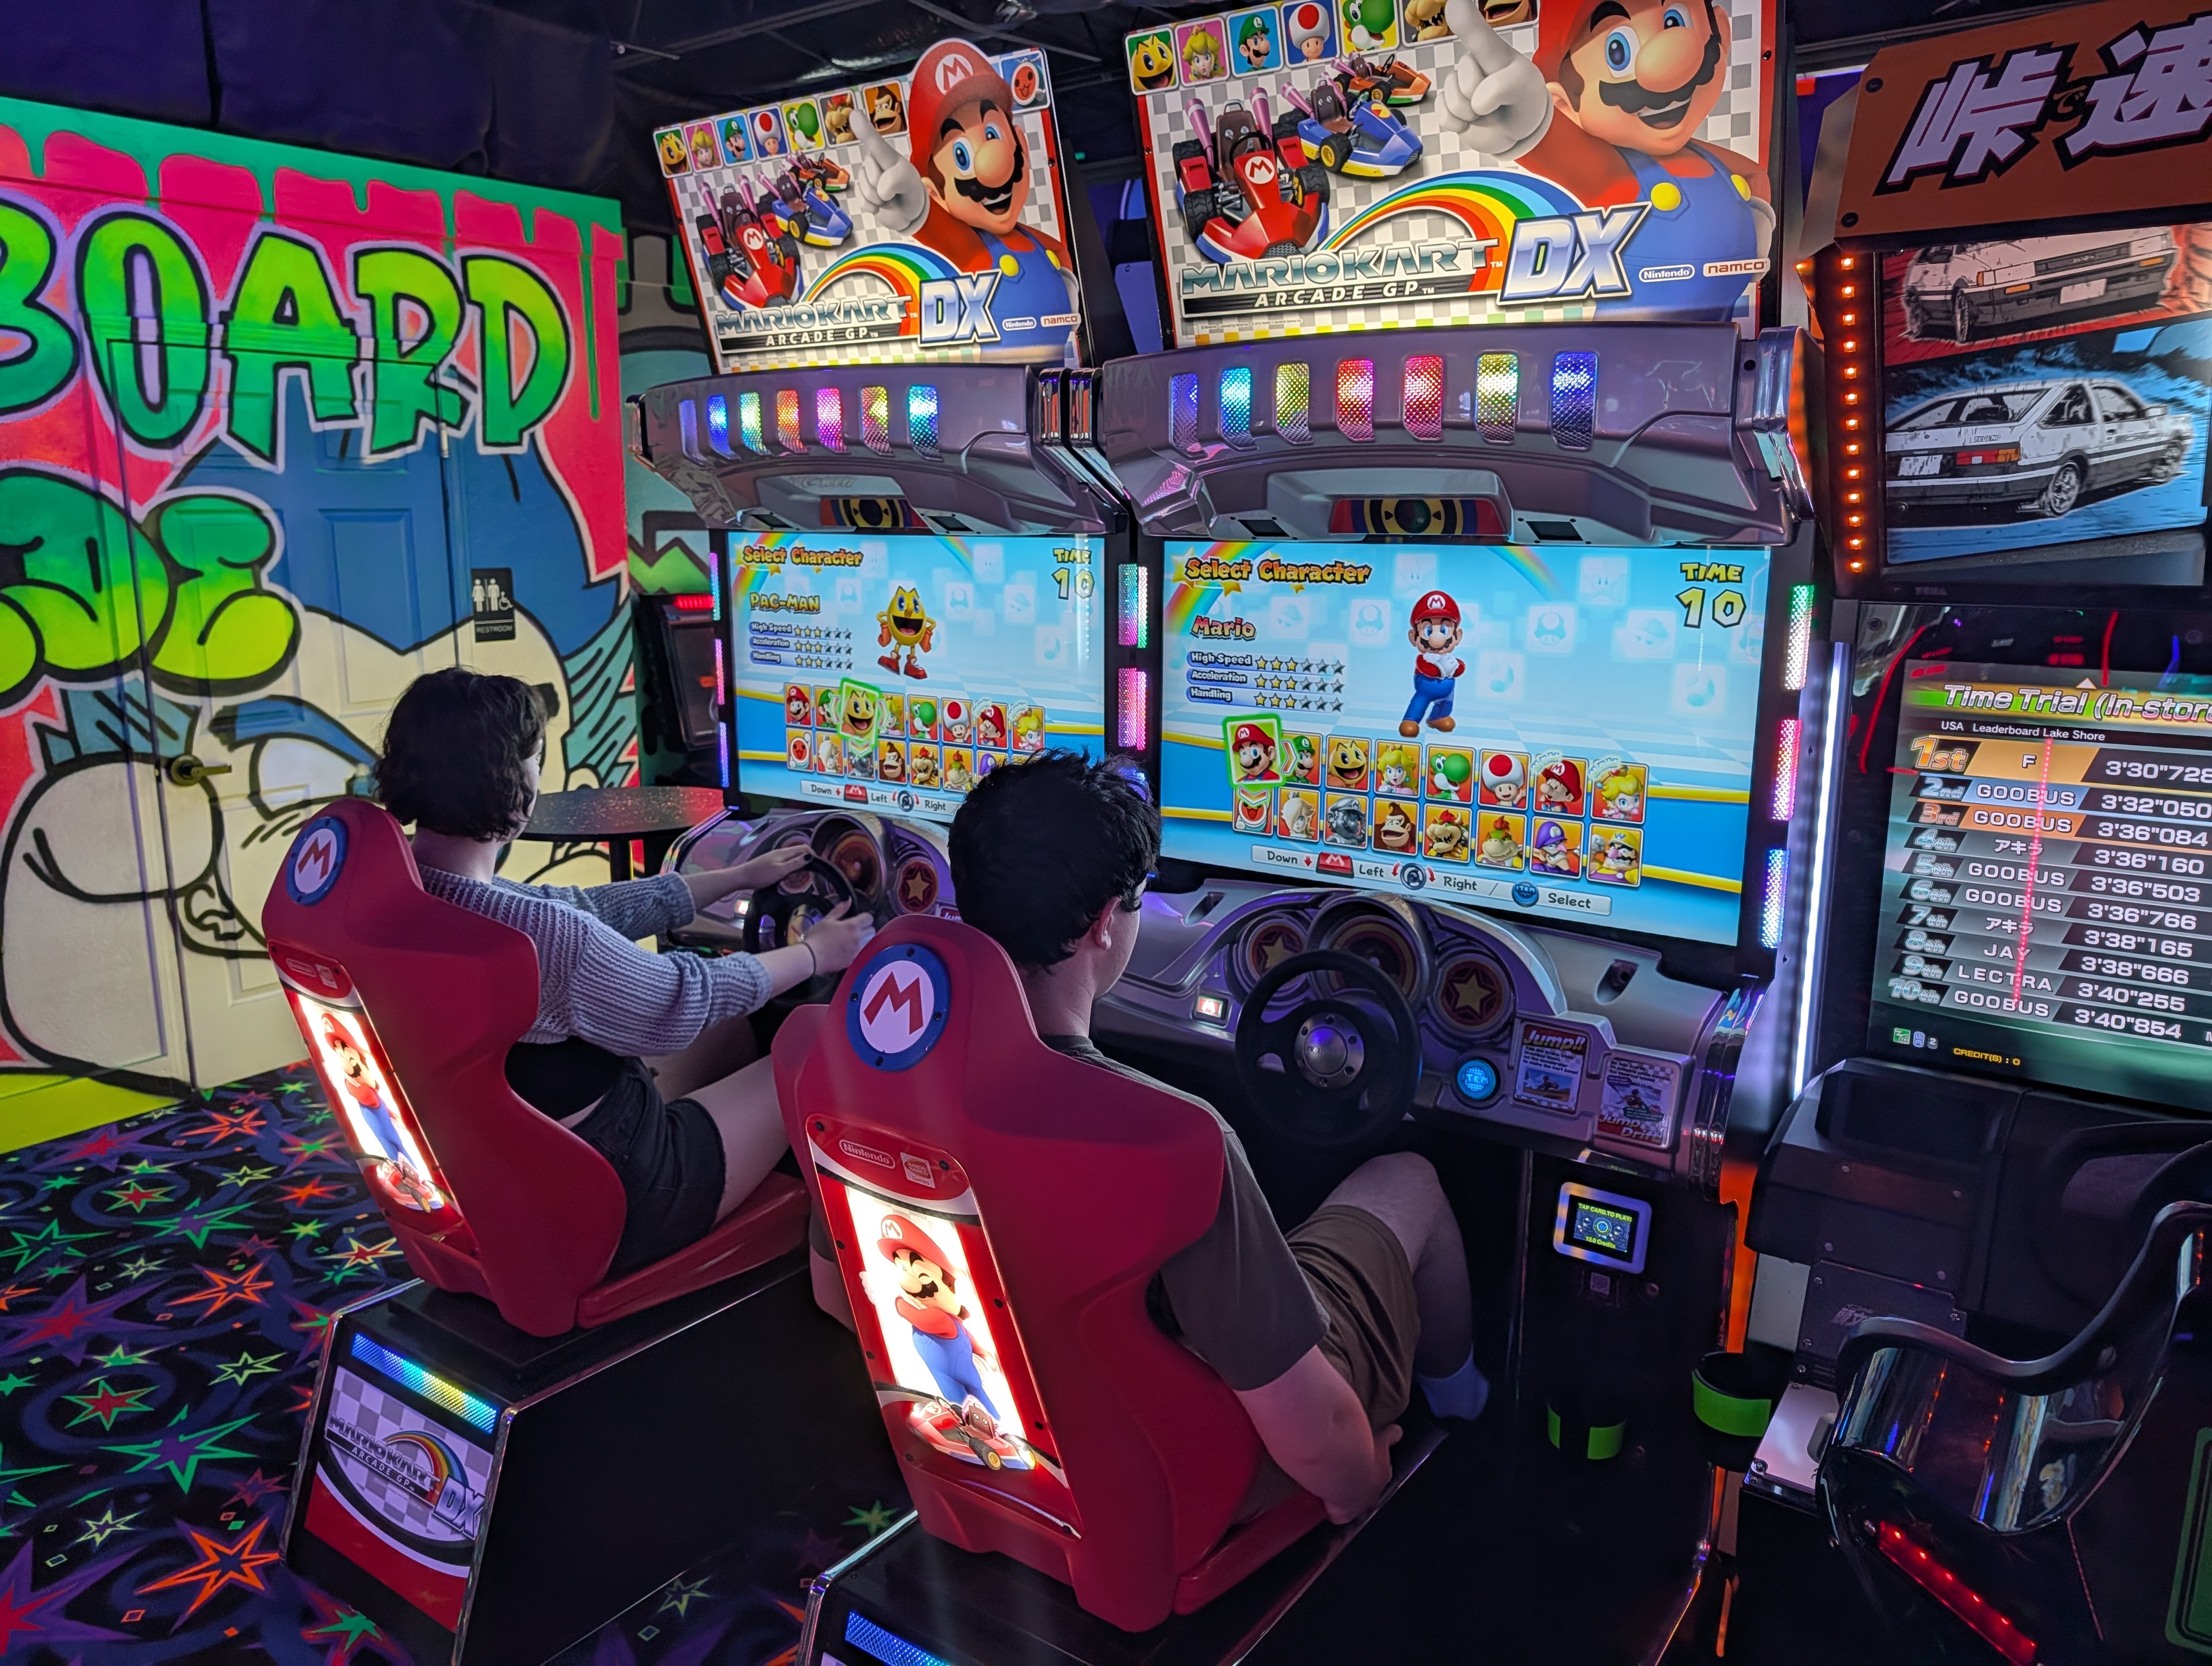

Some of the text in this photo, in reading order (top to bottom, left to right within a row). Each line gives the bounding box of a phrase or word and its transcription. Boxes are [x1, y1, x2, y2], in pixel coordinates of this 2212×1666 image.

[1501, 204, 1650, 302] DX
[1643, 267, 1690, 279] Nintendo
[1707, 261, 1765, 274] namco
[921, 271, 1000, 344] DX
[1254, 285, 1365, 308] ARCADE
[1382, 281, 1418, 297] GP
[1005, 319, 1034, 329] Nintendo
[1043, 315, 1078, 325] namco
[765, 329, 835, 347] ARCADE
[845, 326, 869, 340] GP
[742, 545, 864, 567] Select Character
[1052, 548, 1092, 565] TIME
[1051, 567, 1095, 600] 10
[1185, 556, 1373, 585] Select Character
[1680, 562, 1745, 584] TIME
[749, 592, 821, 614] PAC-MAN
[1674, 586, 1747, 629] 10
[751, 622, 793, 635] High Speed
[1191, 616, 1258, 641] Mario
[1191, 651, 1252, 668] High Speed
[1191, 670, 1248, 684] Acceleration
[1191, 687, 1232, 703] Handling
[1943, 683, 2014, 710] Time
[2018, 687, 2090, 715] Trial
[1941, 720, 2106, 741] USA Leaderboard Lake Shore
[1911, 736, 1969, 772] 1st
[2021, 754, 2037, 769] F
[811, 784, 832, 795] Down
[871, 792, 888, 803] Left
[924, 799, 947, 812] Right
[1921, 777, 1966, 800] 2nd
[1976, 783, 2076, 806] GOOBUS
[1919, 802, 1961, 826] 3rd
[1973, 810, 2073, 833] GOOBUS
[1914, 828, 1957, 852] 4th
[1994, 838, 2044, 857] アキラ
[1266, 850, 1298, 866] Down
[1359, 864, 1384, 878] Left
[1443, 876, 1478, 892] Right
[1547, 892, 1591, 909] Select
[1913, 854, 1954, 877] 5th
[1967, 861, 2067, 887] GOOBUS
[1911, 880, 1952, 905] 6th
[1965, 888, 2062, 913] GOOBUS
[1907, 905, 1949, 930] 7th
[1984, 917, 2034, 935] アキラ
[1905, 930, 1946, 954] 8th
[1983, 944, 2033, 962] JAY
[1902, 955, 1944, 980] 9th
[1958, 964, 2054, 993] LECTRA
[1888, 977, 1941, 1005] 10th
[1953, 990, 2051, 1018] GOOBUS
[1523, 1030, 1586, 1051] Jump!!
[1929, 1037, 1937, 1046] 2
[1953, 1047, 2003, 1063] CREDIT(S)
[1599, 1113, 1641, 1128] Jump
[843, 1142, 891, 1166] Nintendo
[1578, 1202, 1590, 1212] TAP
[351, 1446, 410, 1489] ARCADE GP
[433, 1474, 486, 1540] DX
